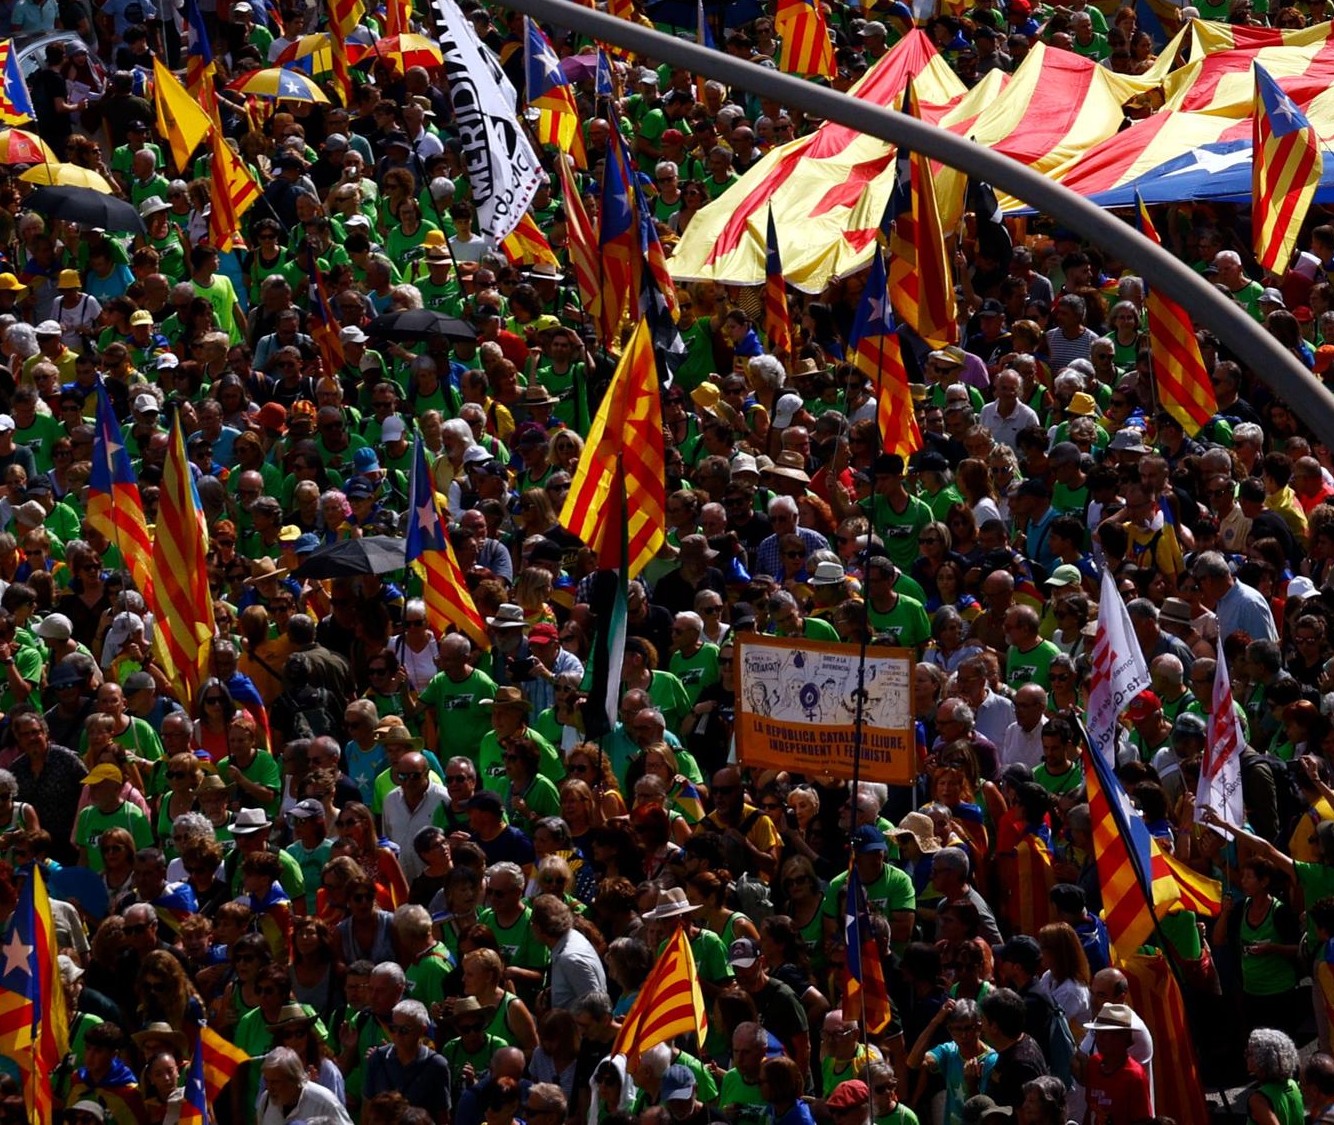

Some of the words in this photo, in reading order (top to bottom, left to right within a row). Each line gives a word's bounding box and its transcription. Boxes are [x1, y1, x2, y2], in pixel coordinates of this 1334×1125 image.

[753, 720, 763, 733] LA
[819, 732, 867, 745] CATALAA
[769, 738, 831, 756] INDEPENDENT
[844, 745, 891, 763] FEINISTA
